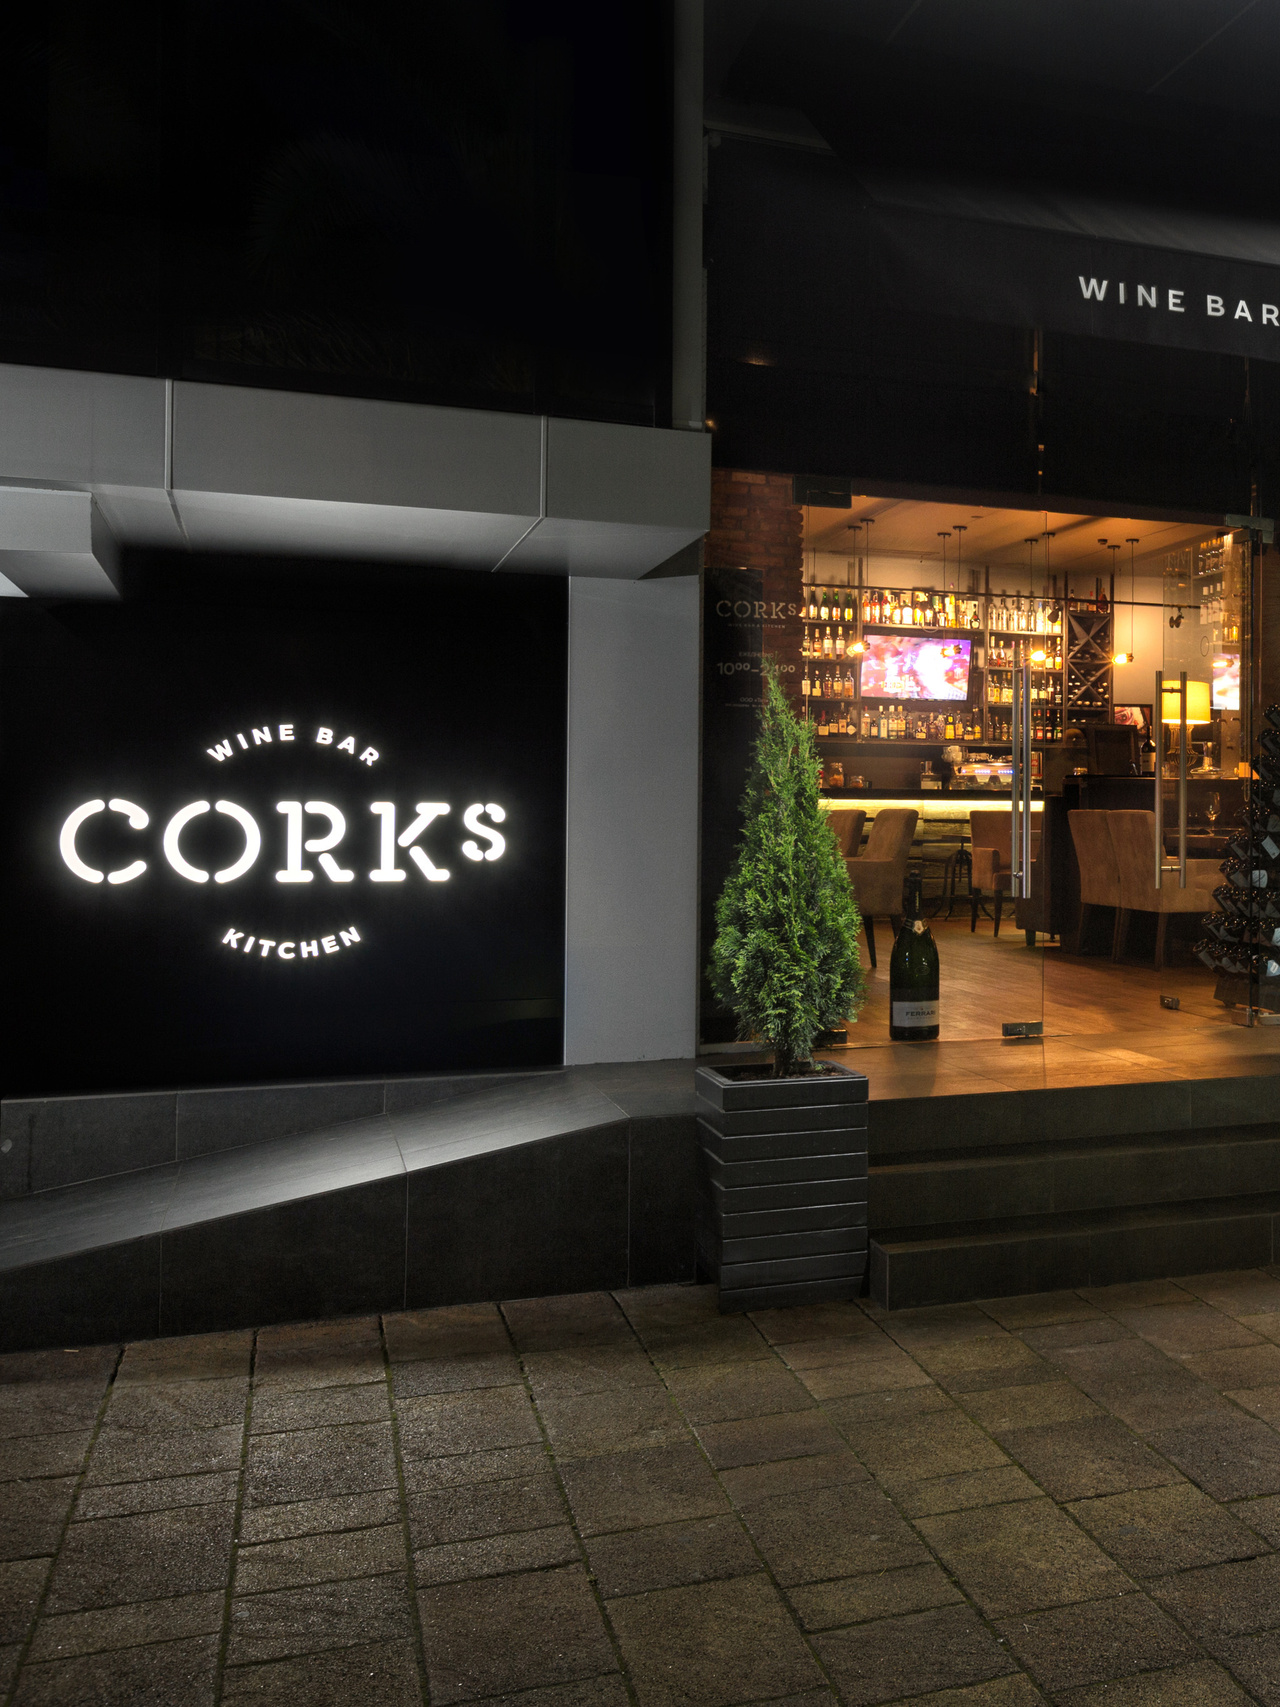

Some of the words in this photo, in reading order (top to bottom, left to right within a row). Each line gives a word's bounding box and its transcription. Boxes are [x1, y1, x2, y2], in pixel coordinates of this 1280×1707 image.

[1078, 275, 1186, 313] WINE
[1206, 294, 1280, 327] BAR
[715, 600, 797, 620] CORKS
[206, 723, 296, 762] WINE
[315, 726, 380, 767] BAR
[59, 798, 507, 885] CORKS
[221, 926, 362, 960] KITCHEN
